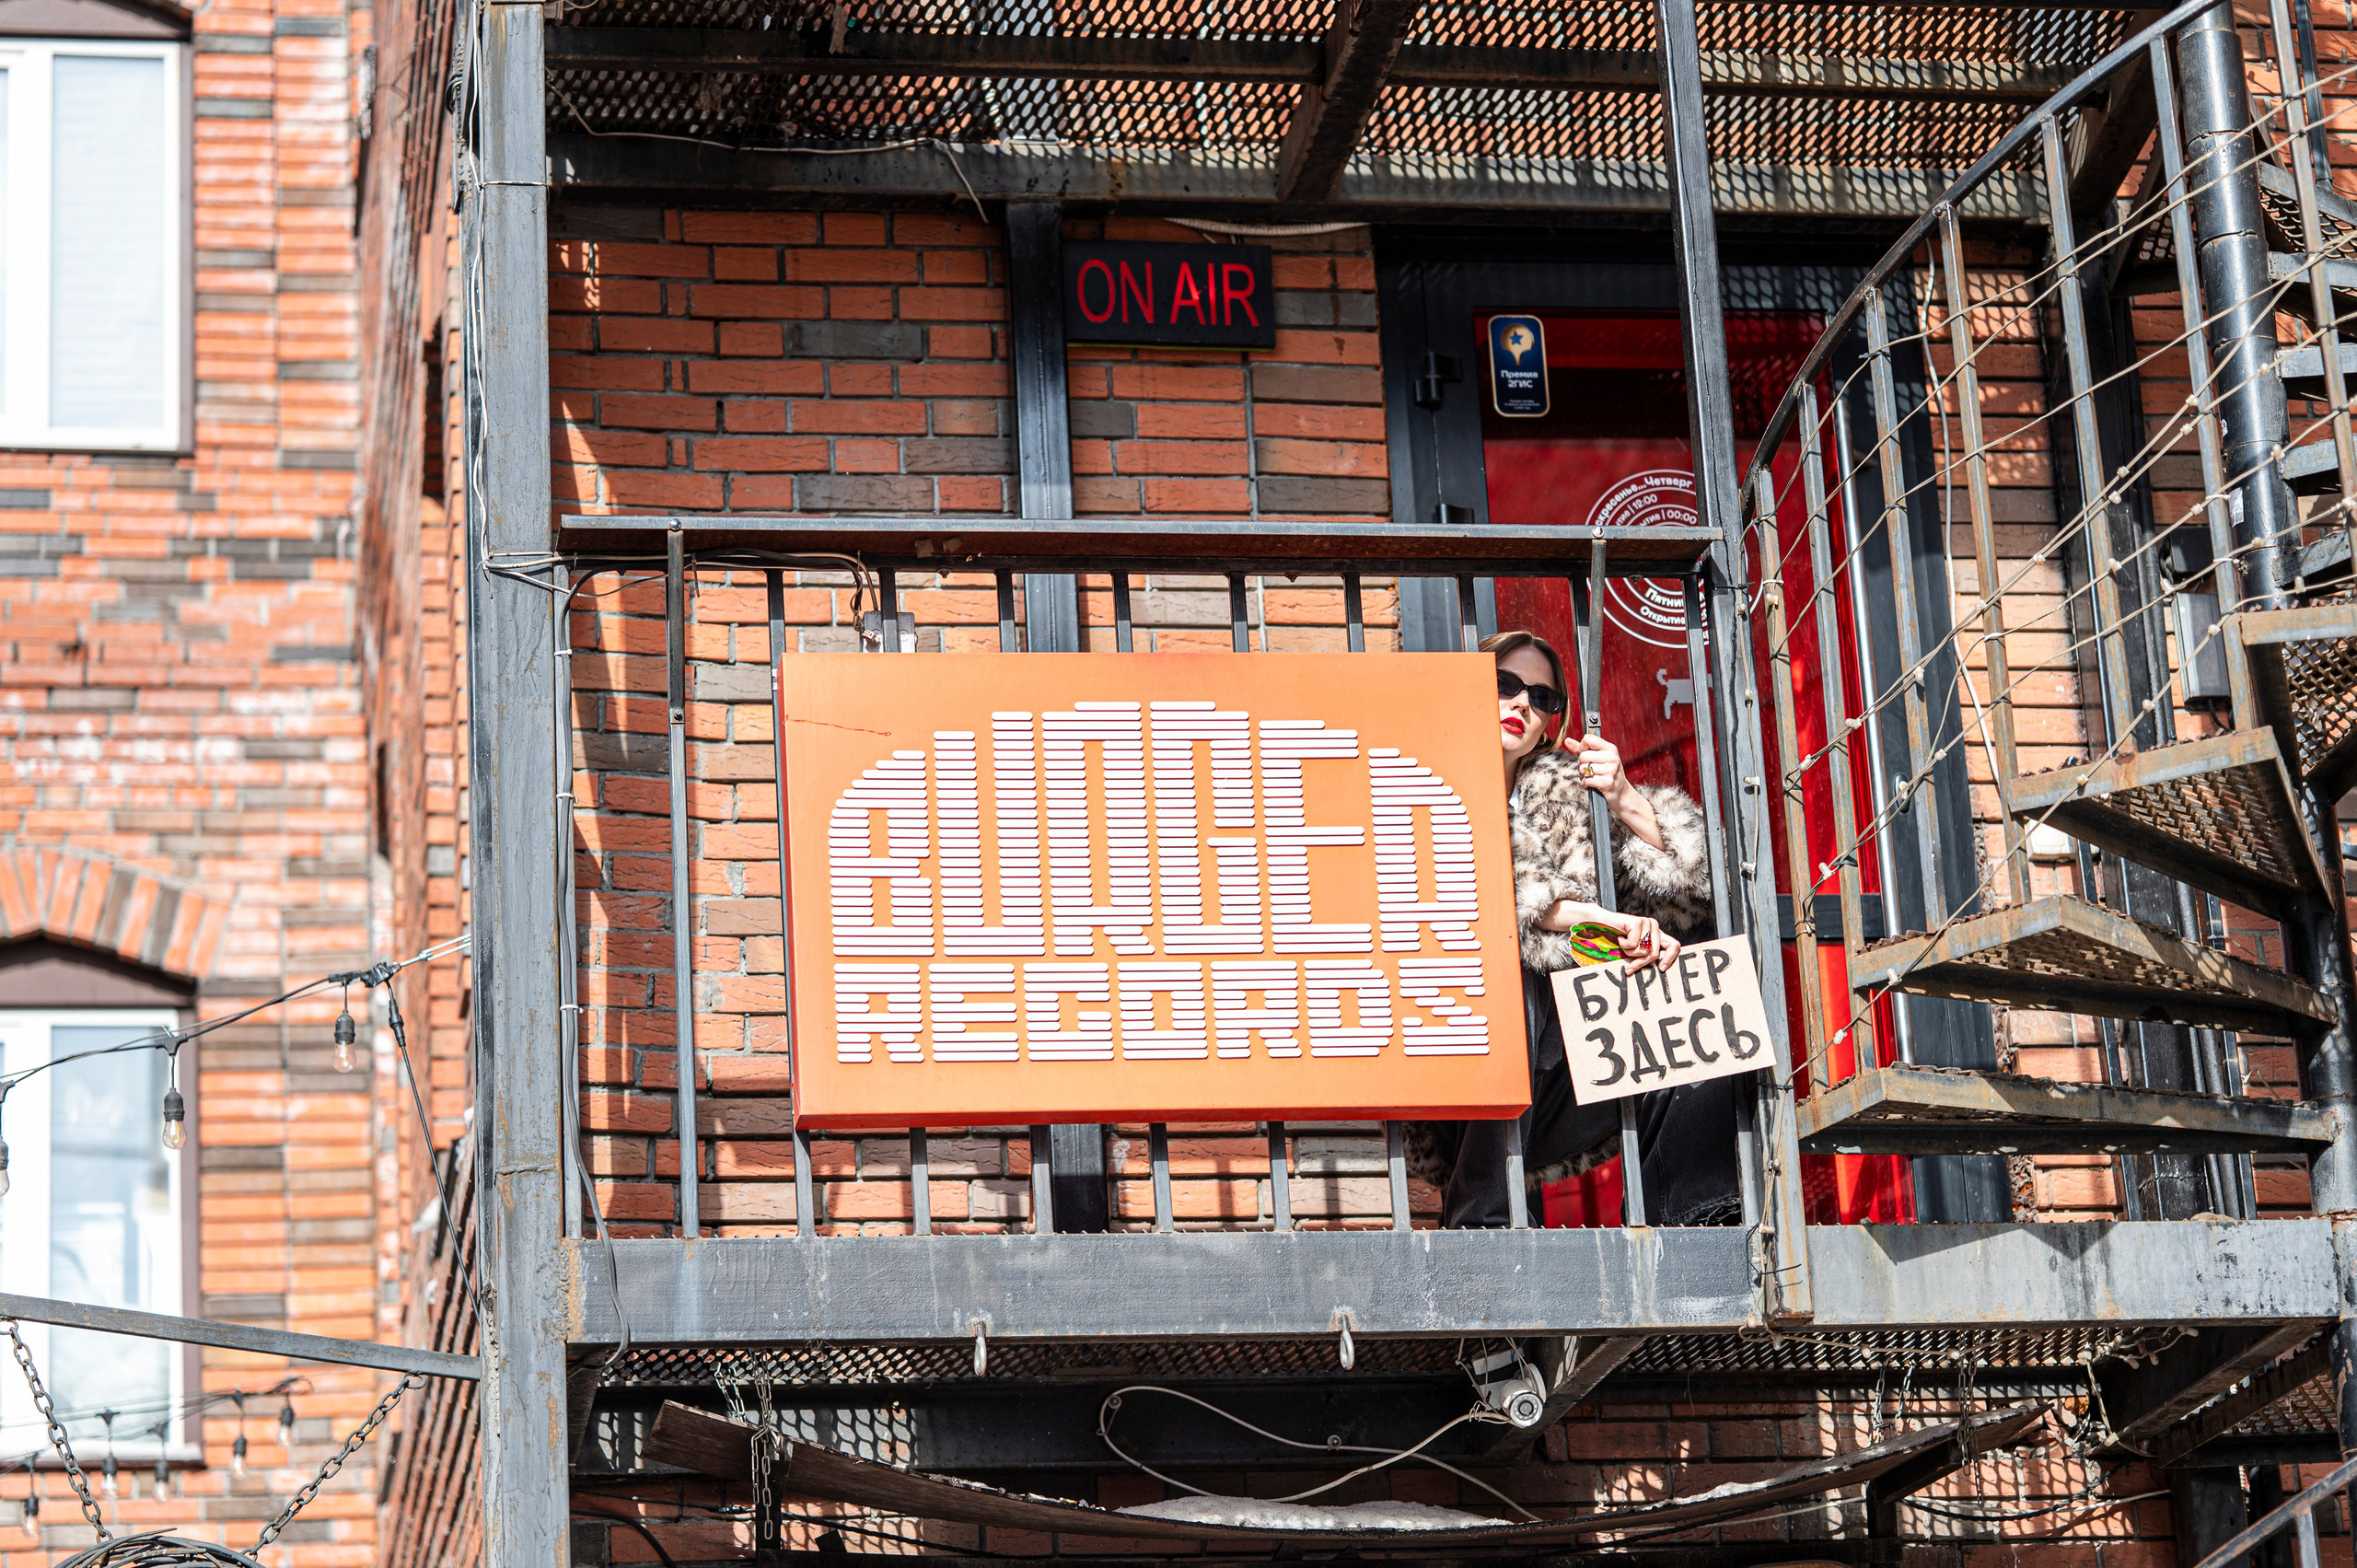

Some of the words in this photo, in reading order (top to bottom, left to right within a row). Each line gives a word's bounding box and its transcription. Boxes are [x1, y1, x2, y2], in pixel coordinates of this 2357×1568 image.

[1076, 259, 1155, 323] ON
[1169, 261, 1260, 327] AIR
[1501, 369, 1538, 379] Премия
[1507, 379, 1534, 389] 2ГИС
[1632, 494, 1658, 510] 12:00
[1666, 509, 1698, 525] 00:00
[828, 701, 1481, 958] BURGER
[833, 958, 1491, 1064] RECORDS
[1573, 948, 1733, 1023] БУРГЕР
[1585, 1002, 1761, 1086] ЗДЕСЬ
